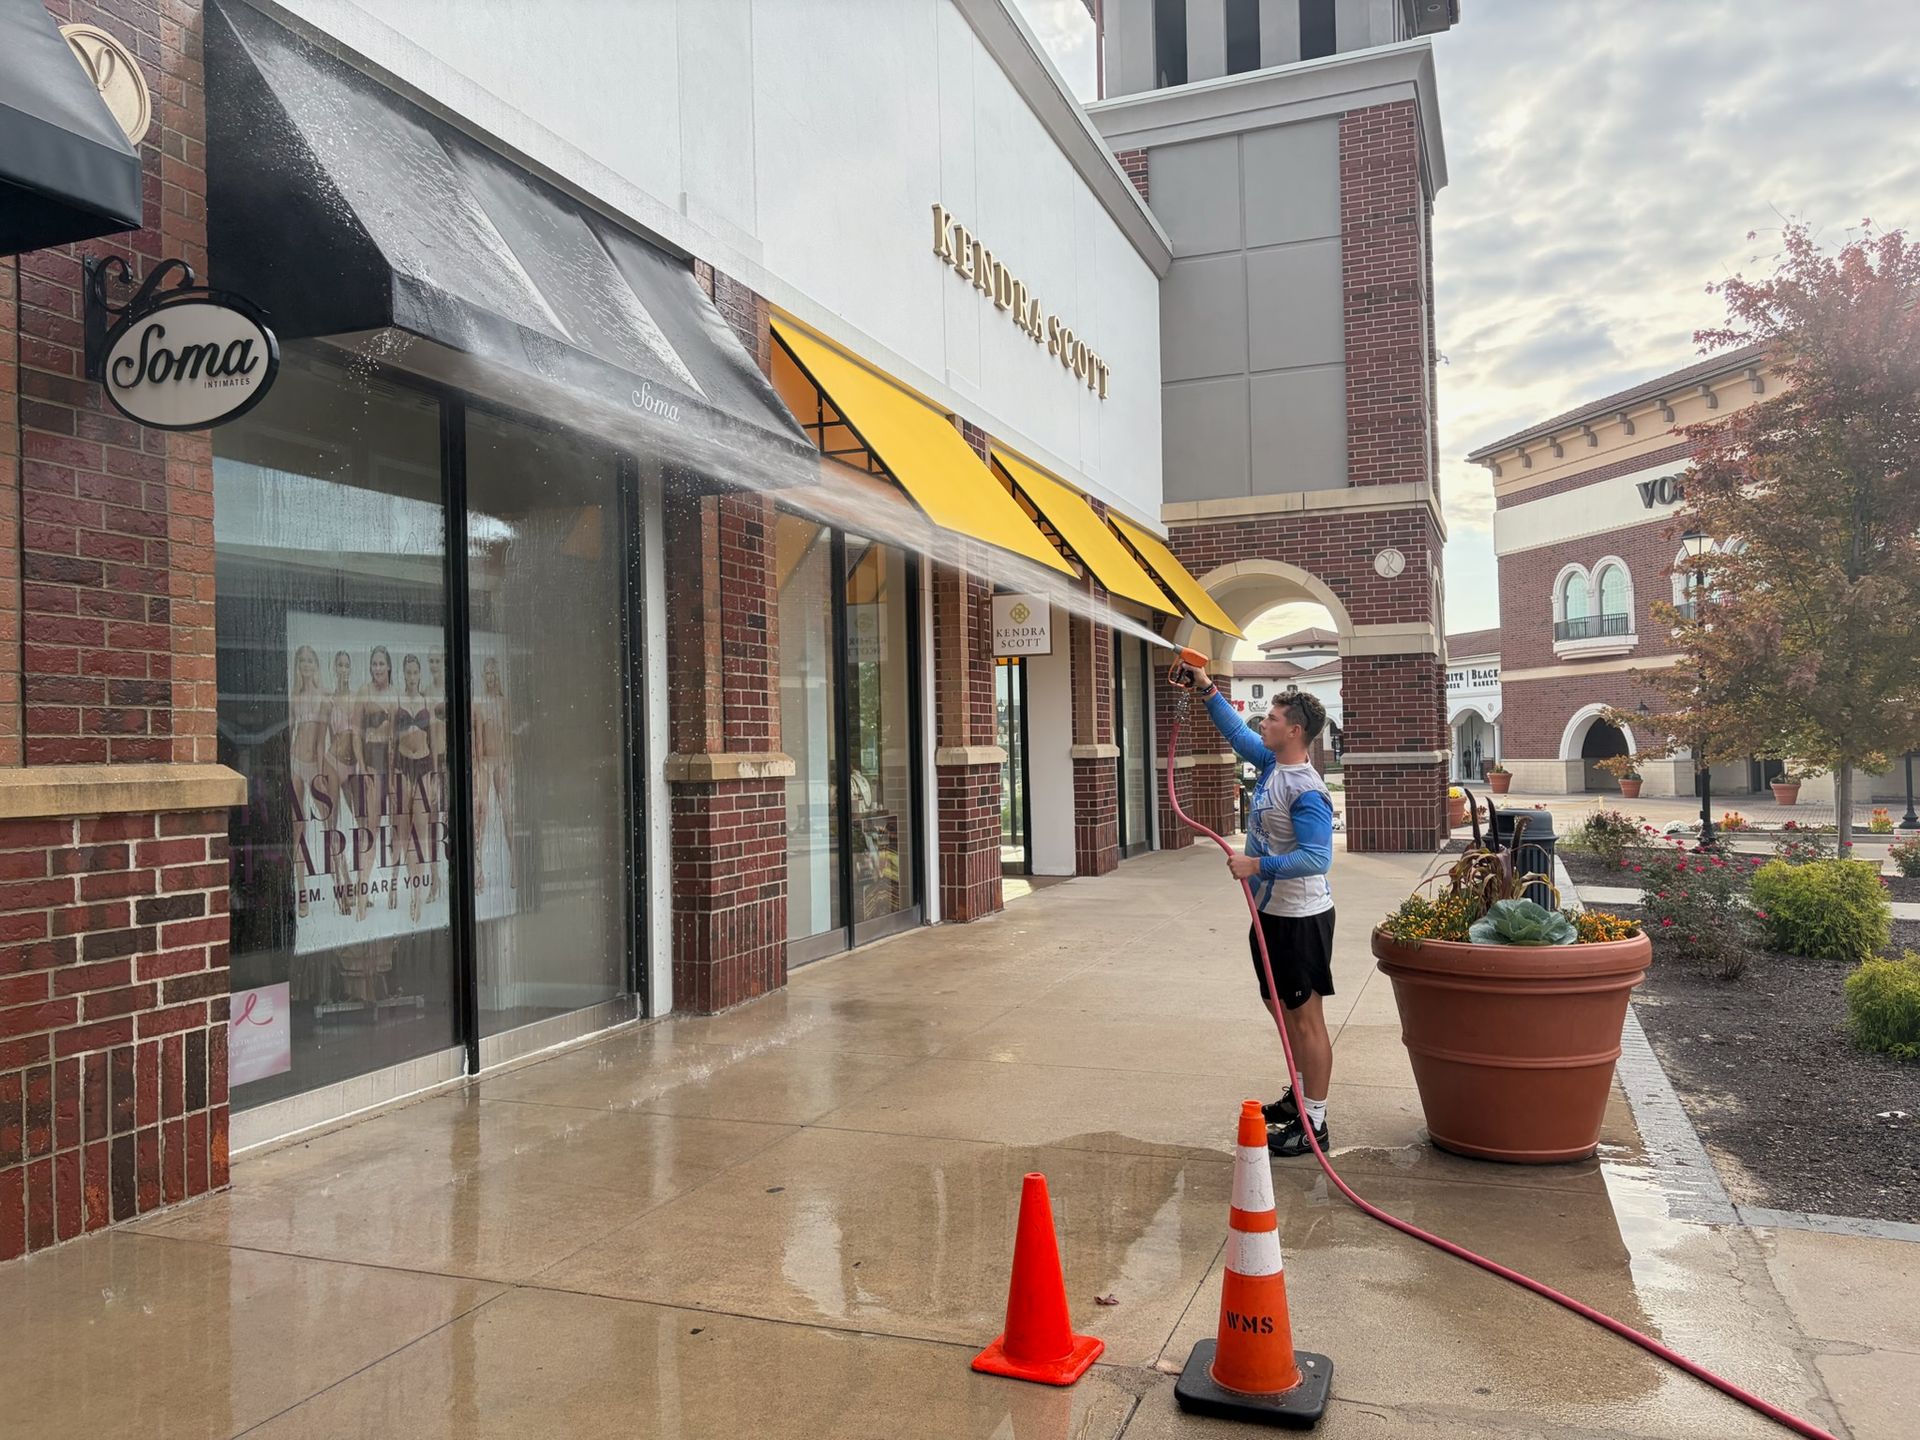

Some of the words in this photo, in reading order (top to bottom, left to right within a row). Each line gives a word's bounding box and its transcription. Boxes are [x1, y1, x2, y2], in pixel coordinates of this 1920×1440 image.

[932, 202, 1045, 344] KENDRA
[1047, 314, 1110, 400] SCOTT
[111, 323, 259, 390] Soma
[203, 376, 251, 390] INTIMATES
[631, 381, 681, 422] Soma
[1635, 472, 1687, 509] VO
[996, 627, 1046, 638] KENDRA
[1001, 638, 1041, 648] SCOTT
[333, 884, 356, 900] WE
[360, 878, 398, 896] DARE
[1226, 1310, 1274, 1334] WMS
